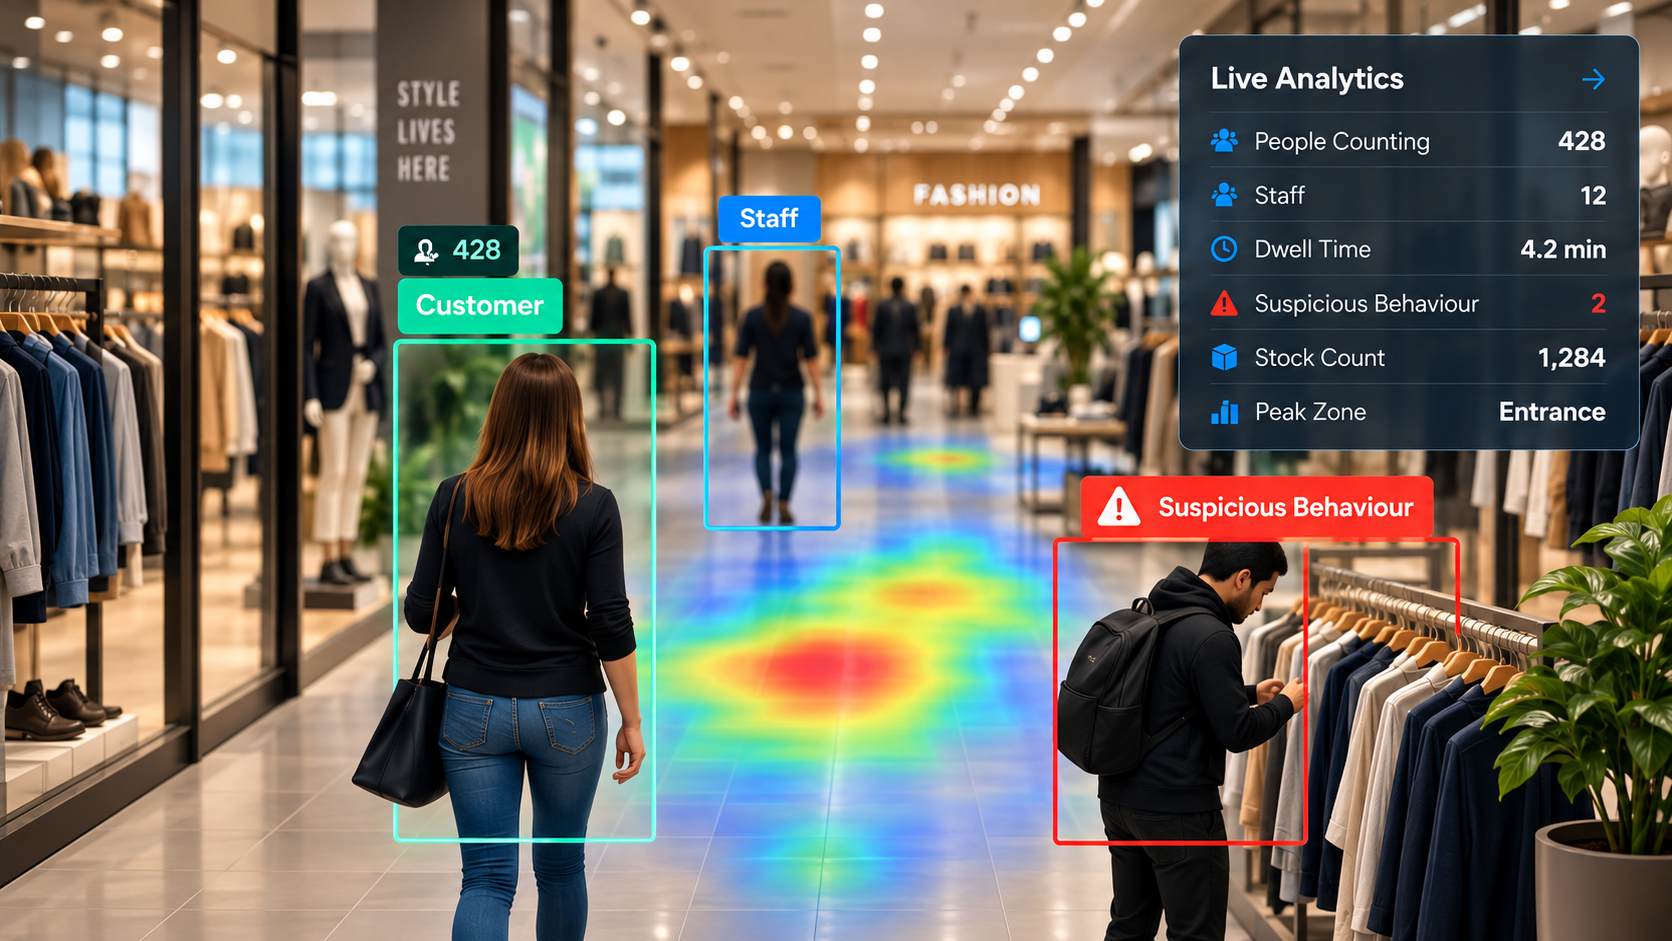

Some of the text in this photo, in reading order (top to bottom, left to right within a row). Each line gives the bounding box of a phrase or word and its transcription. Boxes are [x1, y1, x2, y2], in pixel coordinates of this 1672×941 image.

[397, 80, 460, 107] STYLE
[397, 118, 456, 145] LIVES
[398, 155, 449, 181] HERE
[913, 183, 1041, 206] FASHION
